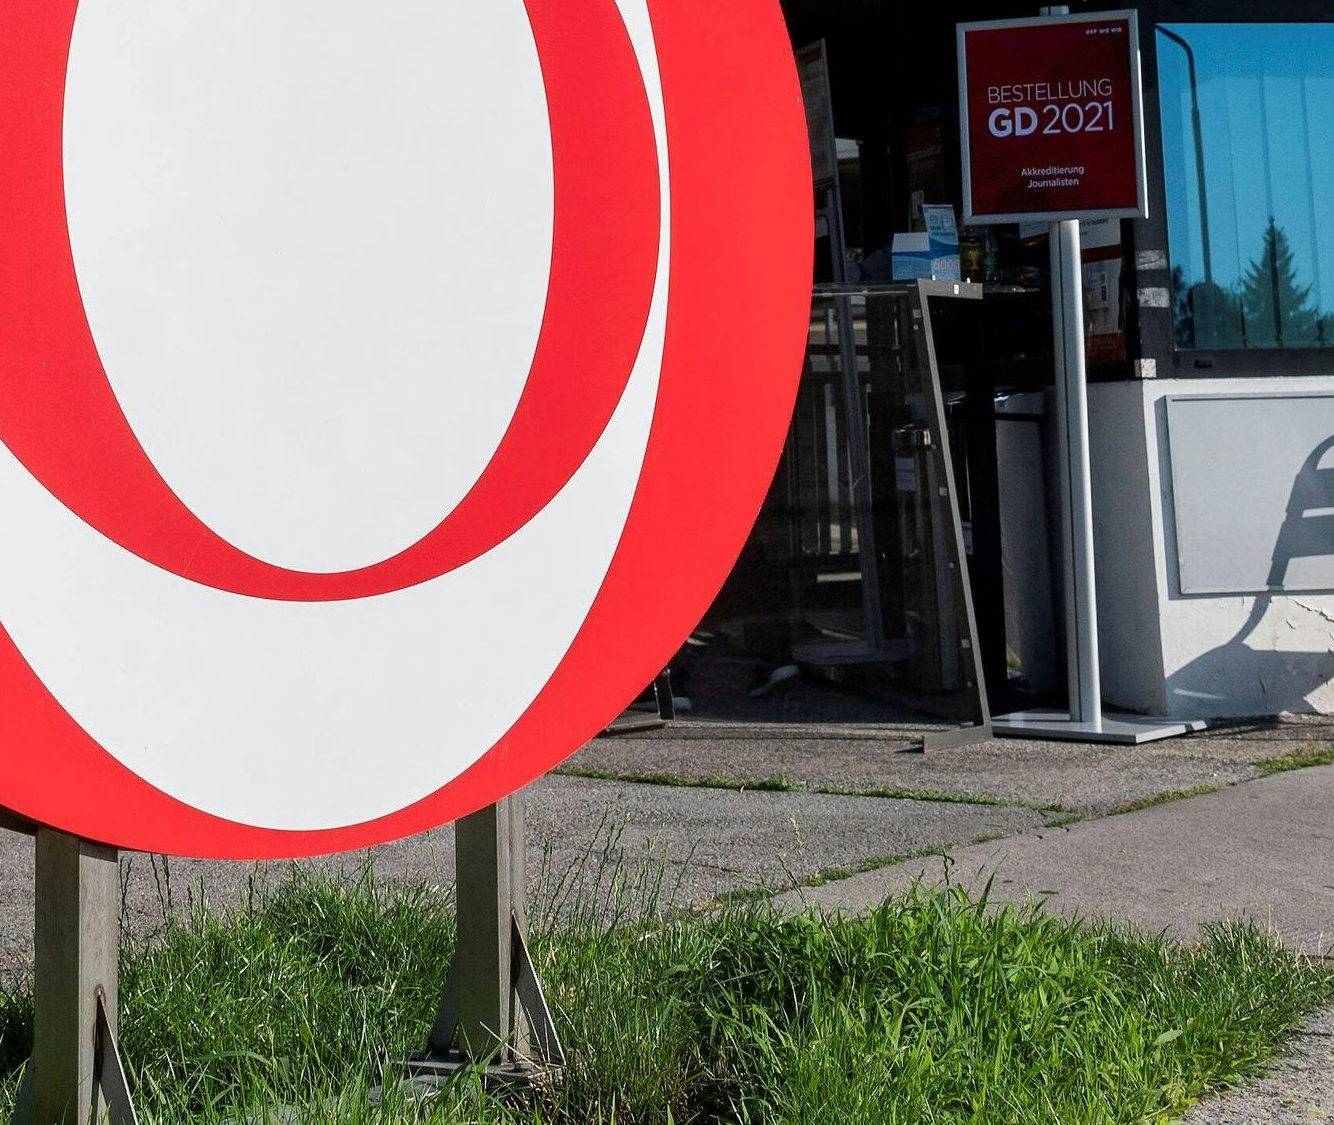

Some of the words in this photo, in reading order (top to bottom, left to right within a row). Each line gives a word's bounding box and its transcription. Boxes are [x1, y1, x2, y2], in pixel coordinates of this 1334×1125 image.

[987, 78, 1113, 104] BESTELLUNG
[1020, 165, 1085, 177] Akkreditierung
[1027, 178, 1079, 189] Journalisten
